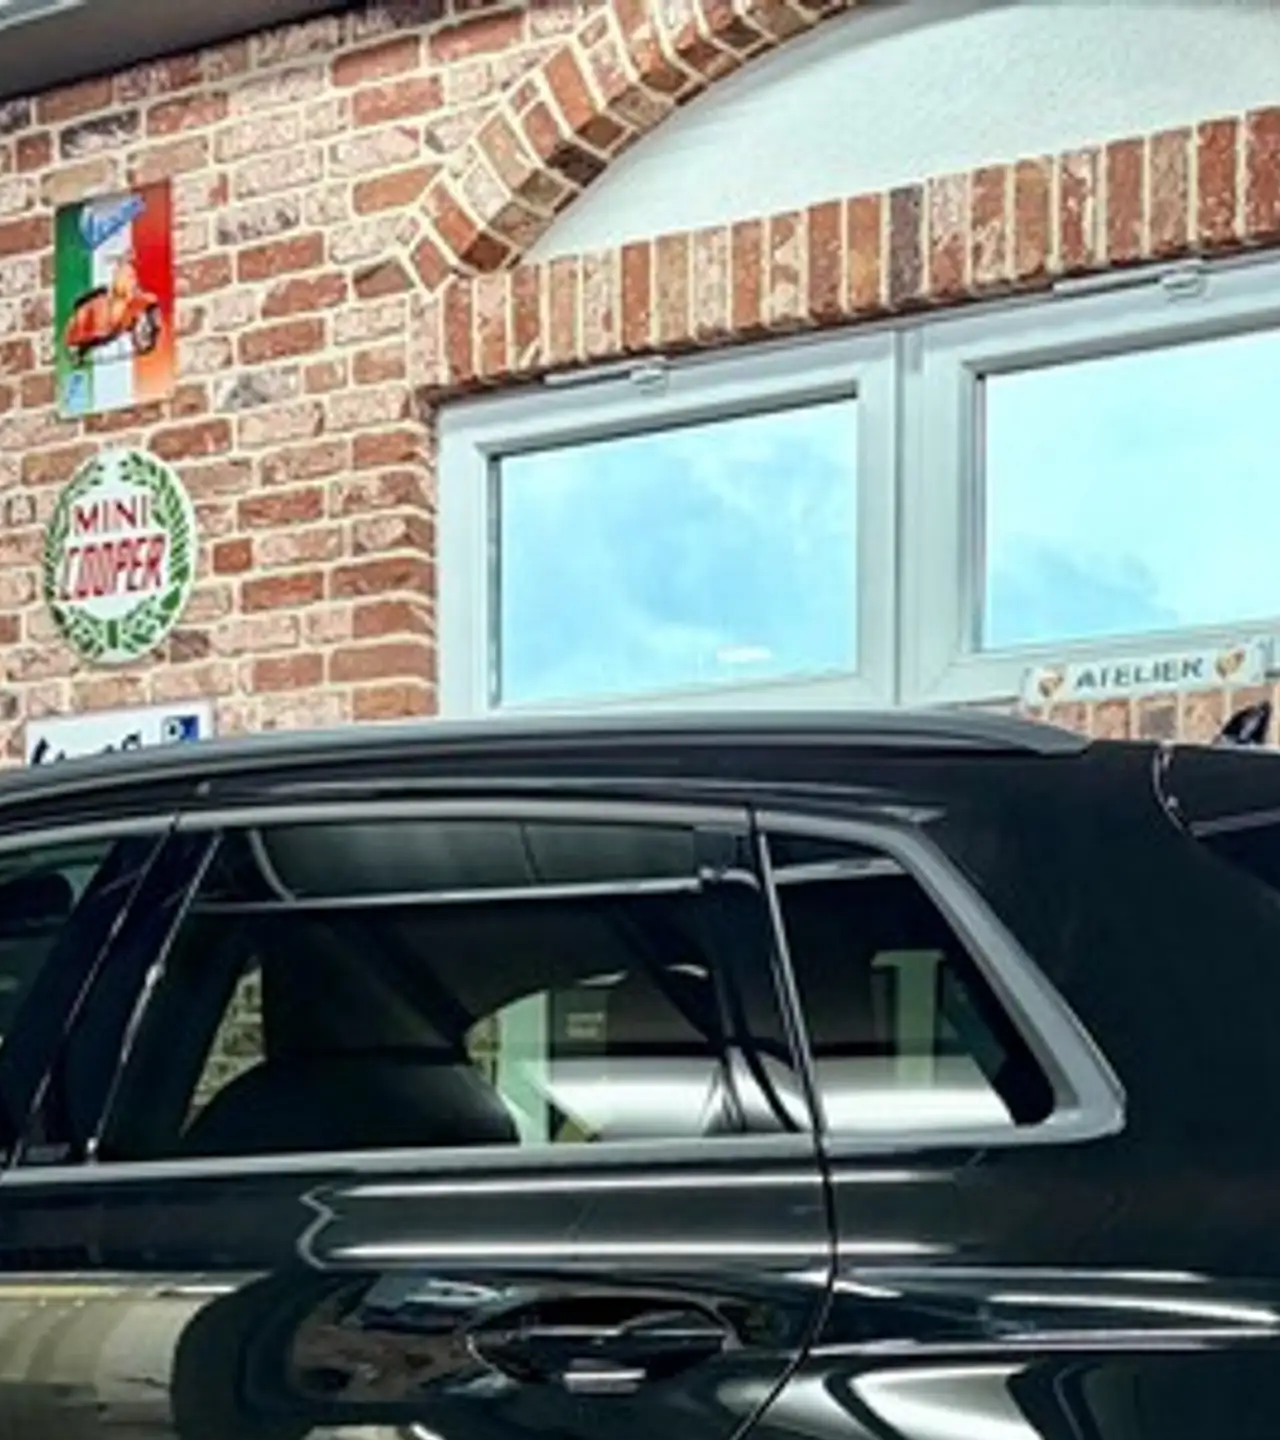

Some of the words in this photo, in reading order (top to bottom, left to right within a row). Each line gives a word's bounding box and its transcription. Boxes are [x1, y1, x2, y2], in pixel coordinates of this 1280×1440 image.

[74, 494, 148, 537] MINI
[61, 533, 166, 600] COOPER
[1074, 657, 1204, 690] ATELIER
